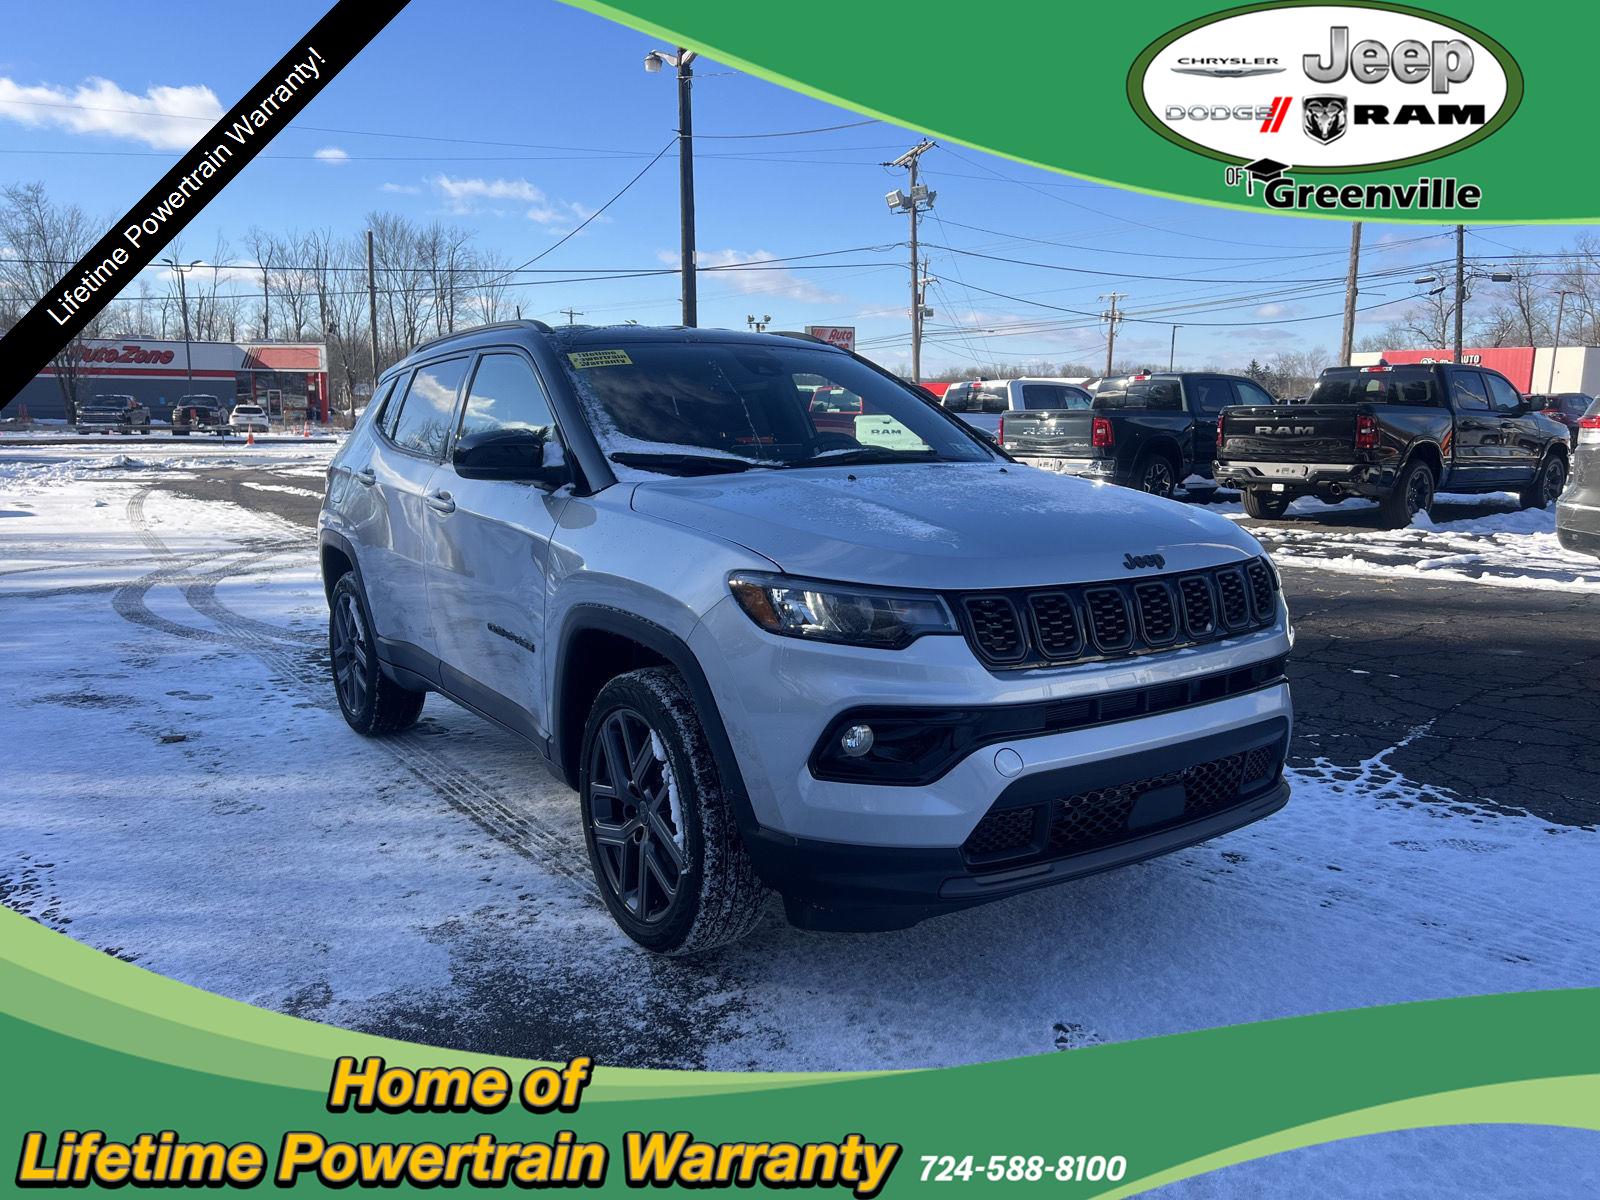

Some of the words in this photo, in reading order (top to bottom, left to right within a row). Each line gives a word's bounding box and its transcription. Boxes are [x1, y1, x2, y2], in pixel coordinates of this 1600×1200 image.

[828, 329, 853, 340] Auto
[1254, 426, 1315, 435] RAM
[1122, 553, 1166, 570] Jeep
